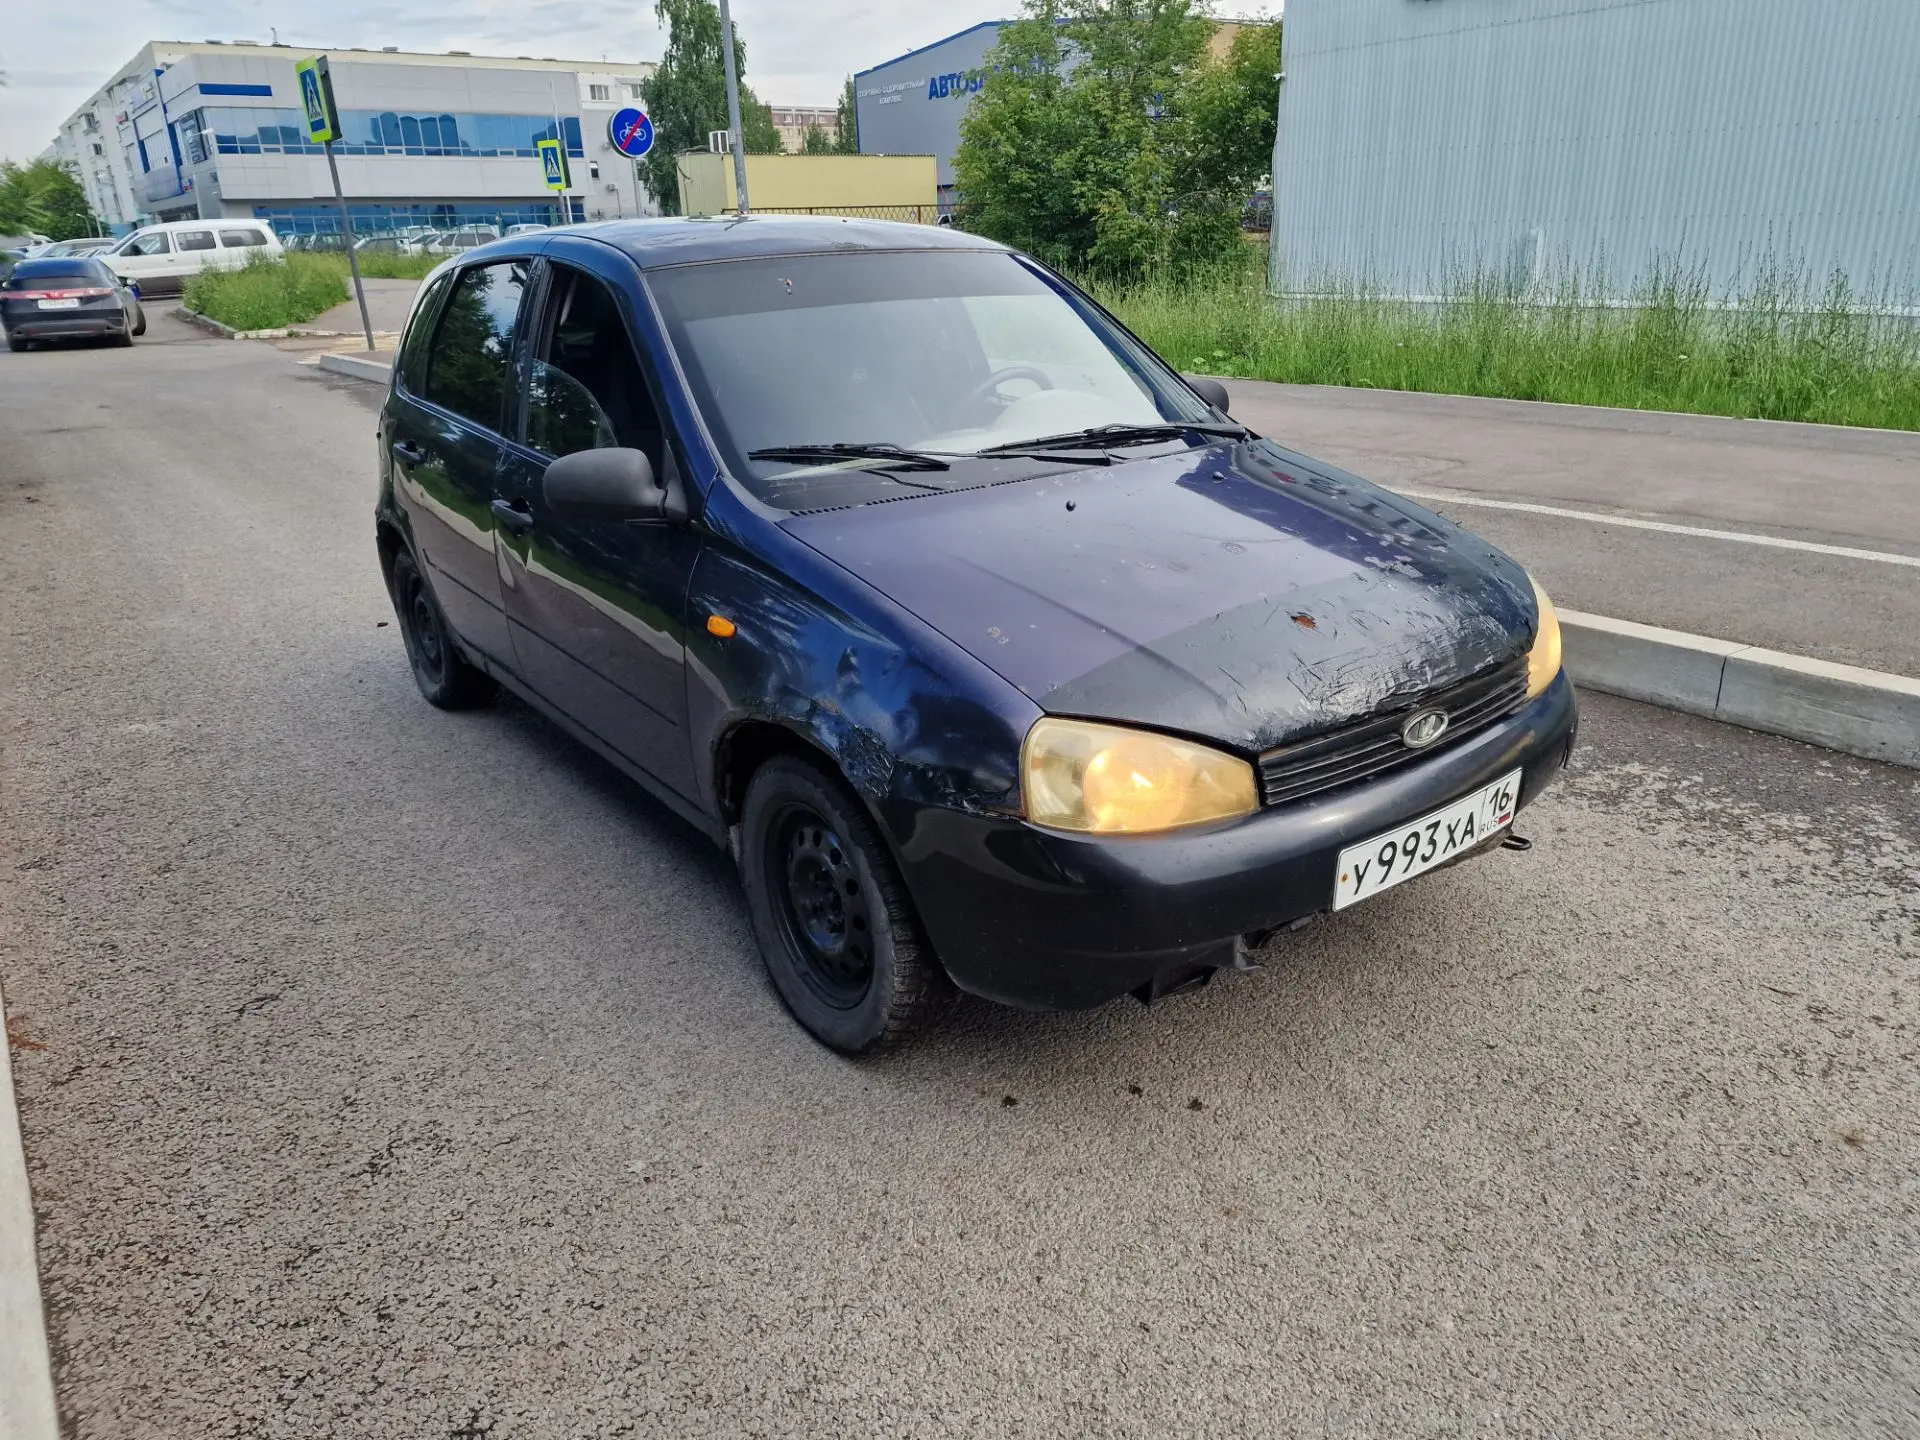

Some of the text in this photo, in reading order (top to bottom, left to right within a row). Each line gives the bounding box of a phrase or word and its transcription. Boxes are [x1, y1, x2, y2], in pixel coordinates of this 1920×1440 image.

[1353, 781, 1511, 895] У993ХА 16
[1479, 816, 1498, 833] RUS
